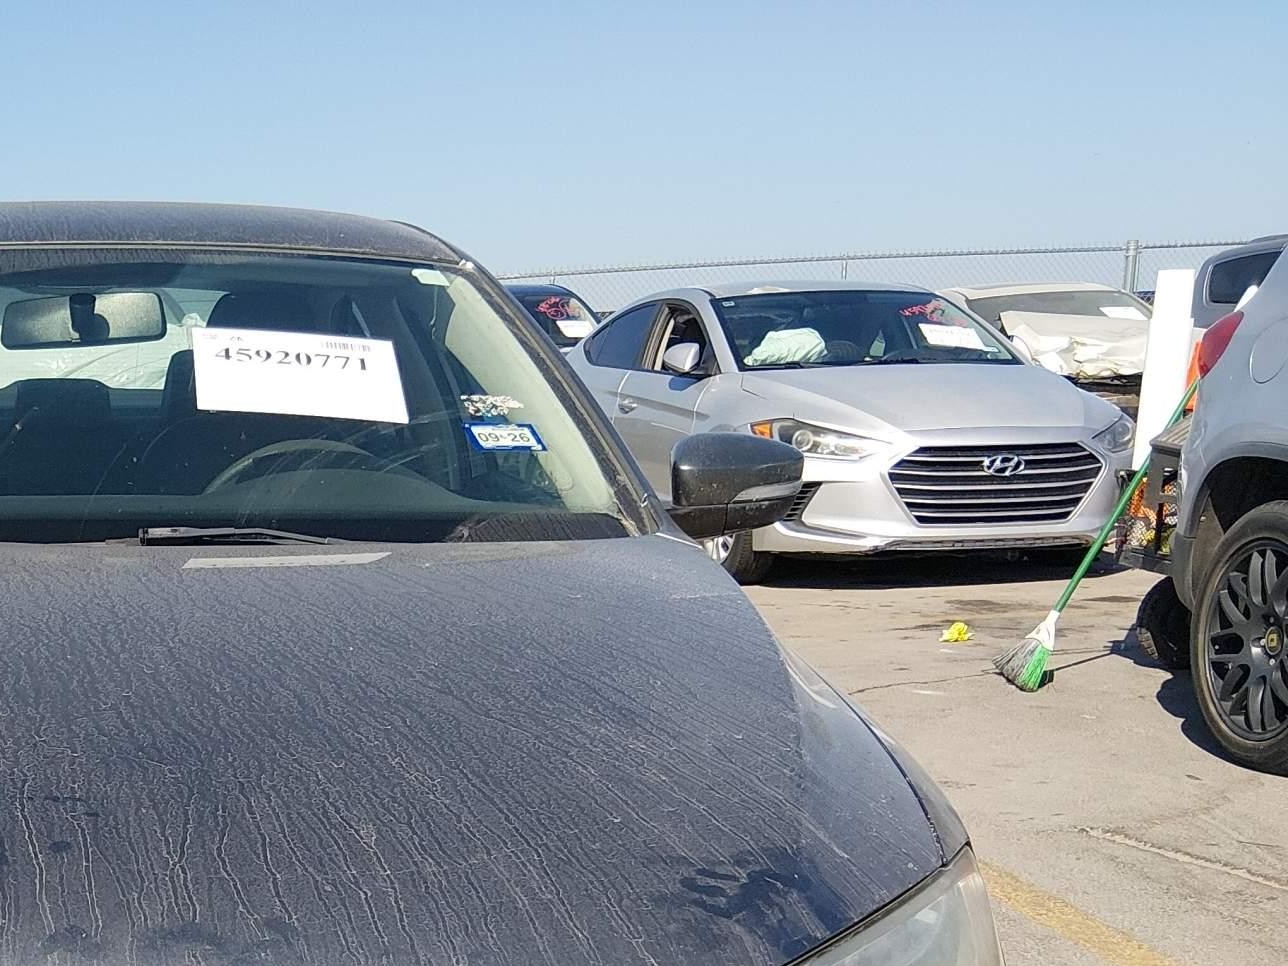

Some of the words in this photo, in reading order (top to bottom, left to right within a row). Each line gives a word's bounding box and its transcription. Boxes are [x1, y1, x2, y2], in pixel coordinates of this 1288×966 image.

[215, 347, 368, 371] 45920771
[477, 433, 500, 442] 09
[507, 433, 530, 443] 26
